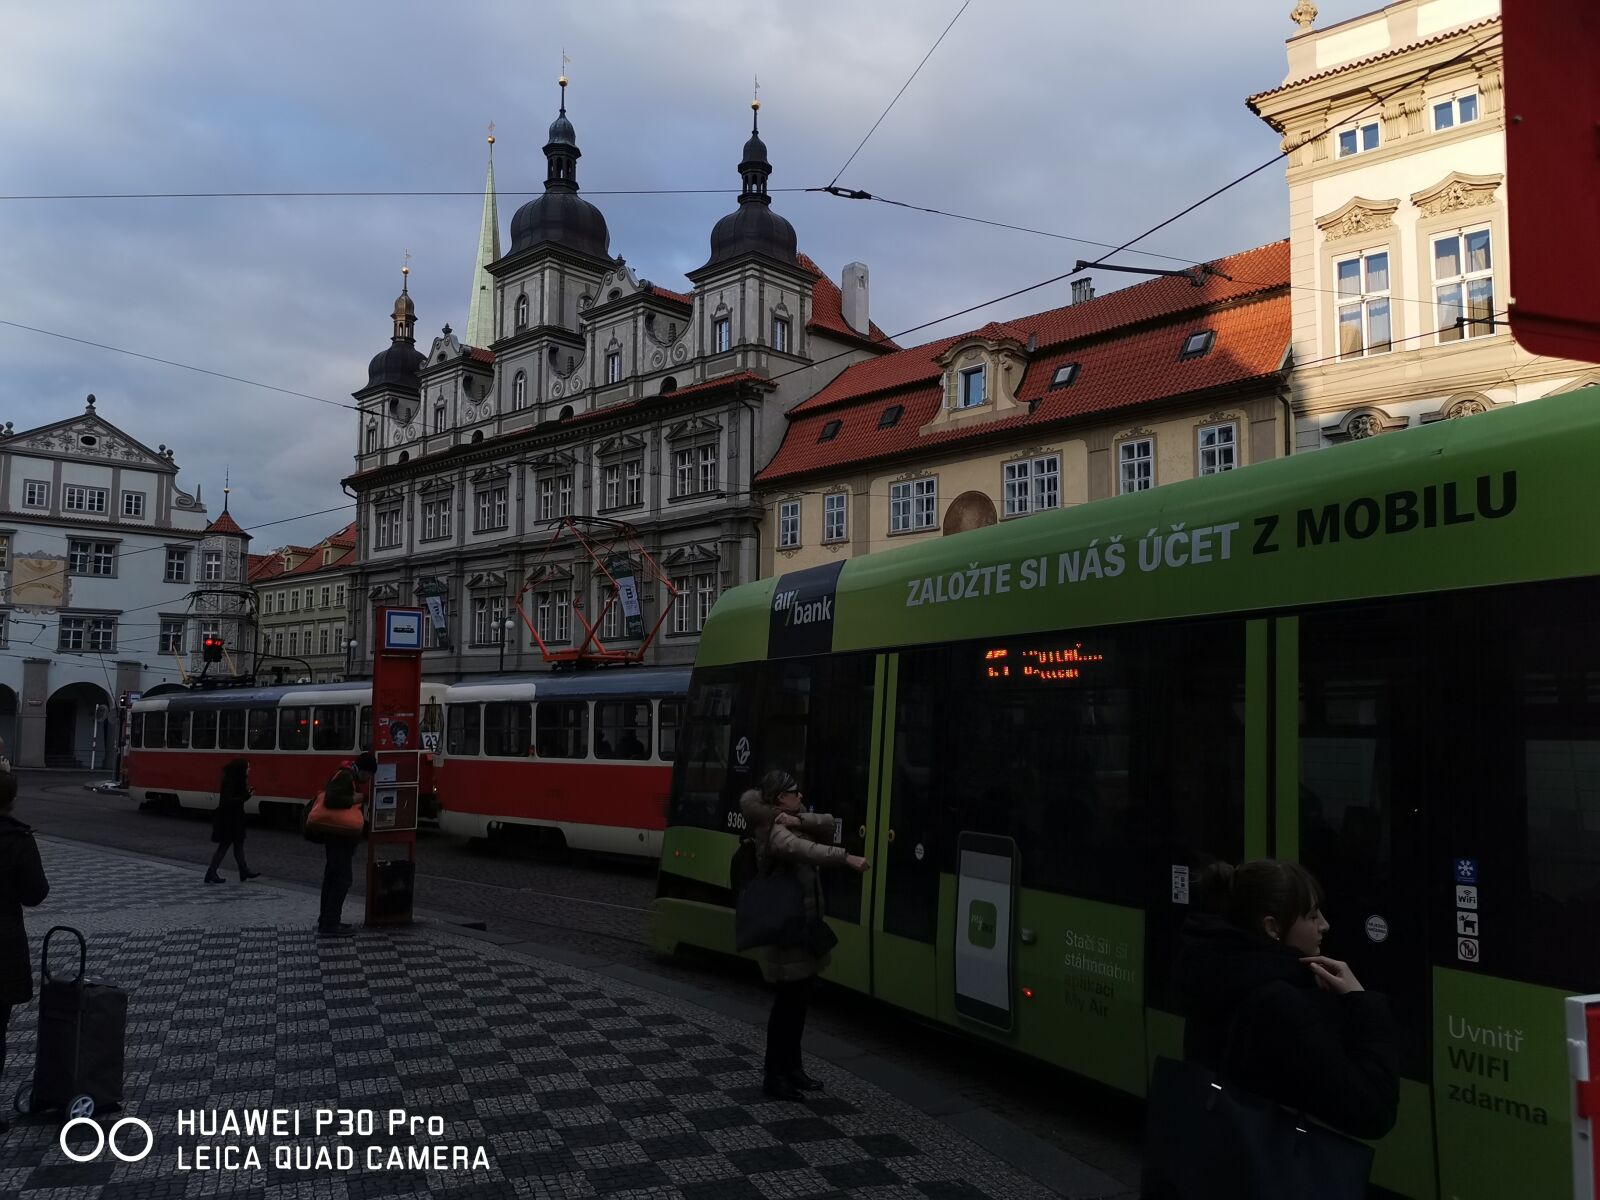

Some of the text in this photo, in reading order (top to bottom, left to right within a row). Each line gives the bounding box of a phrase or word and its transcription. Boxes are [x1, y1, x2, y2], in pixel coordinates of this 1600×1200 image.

[905, 471, 1517, 607] ZALOŽTE SI NÁŠ ÚČET Z MOBILU
[1448, 1014, 1525, 1053] Uvnitř
[1447, 1046, 1510, 1082] WIFI
[1448, 1083, 1548, 1126] zdarma
